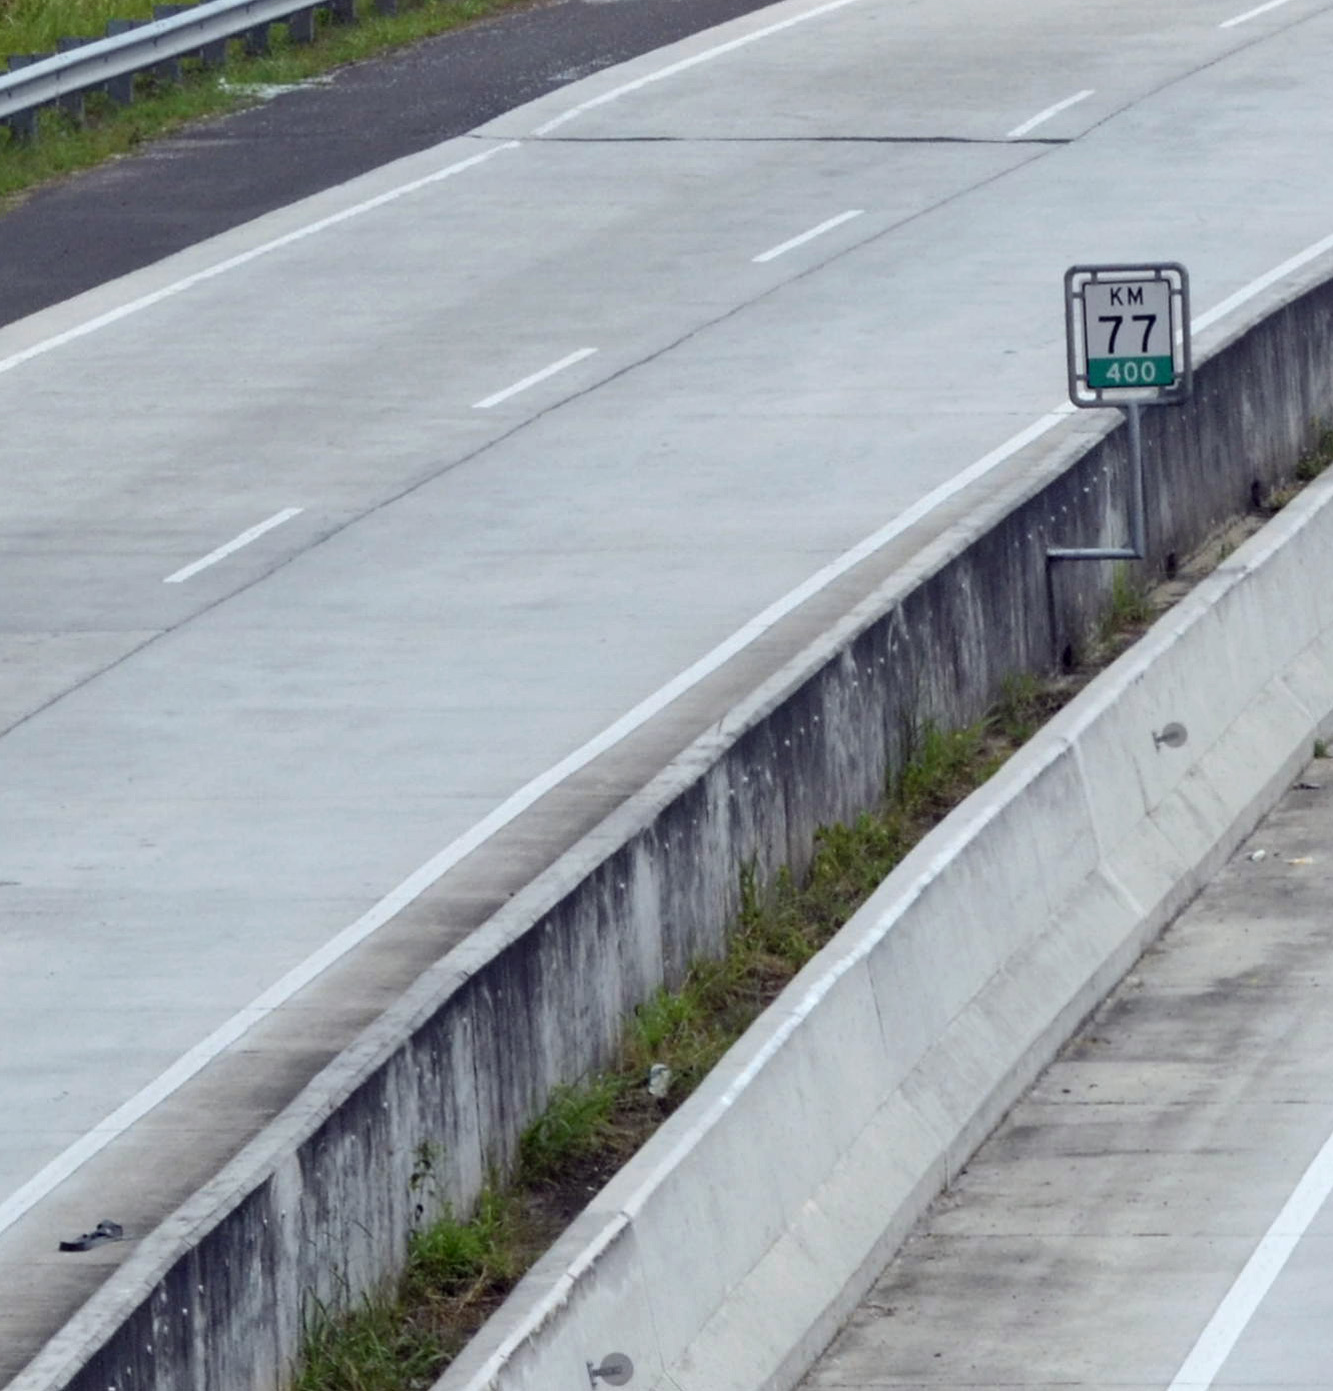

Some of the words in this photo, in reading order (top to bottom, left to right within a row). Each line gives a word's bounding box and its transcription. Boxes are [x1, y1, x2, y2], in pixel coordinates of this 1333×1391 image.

[1110, 286, 1144, 307] KM
[1098, 314, 1157, 355] 77
[1105, 361, 1156, 383] 400
